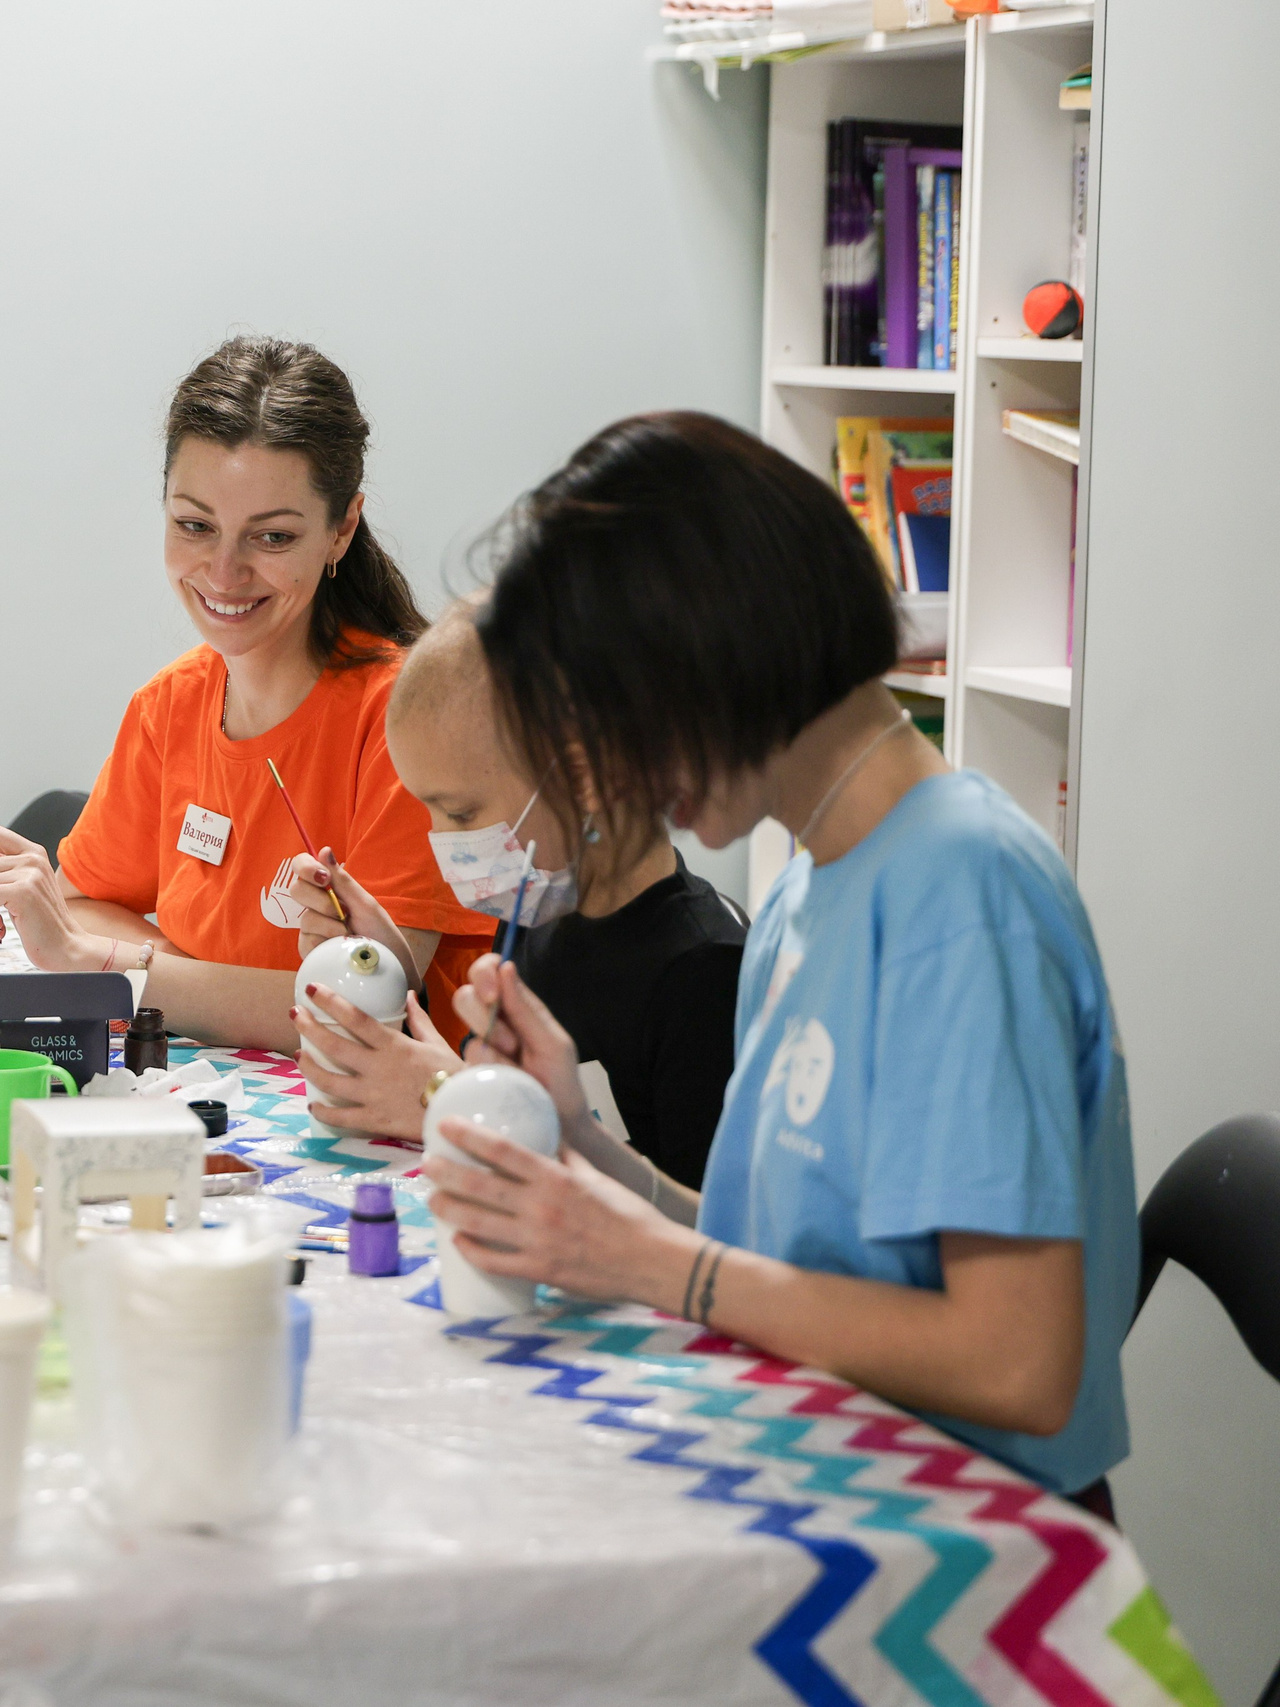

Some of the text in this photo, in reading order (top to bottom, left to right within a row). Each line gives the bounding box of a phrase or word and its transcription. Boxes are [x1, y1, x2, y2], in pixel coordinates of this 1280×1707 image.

[183, 821, 224, 849] Валерия
[31, 1036, 77, 1048] GLASS &
